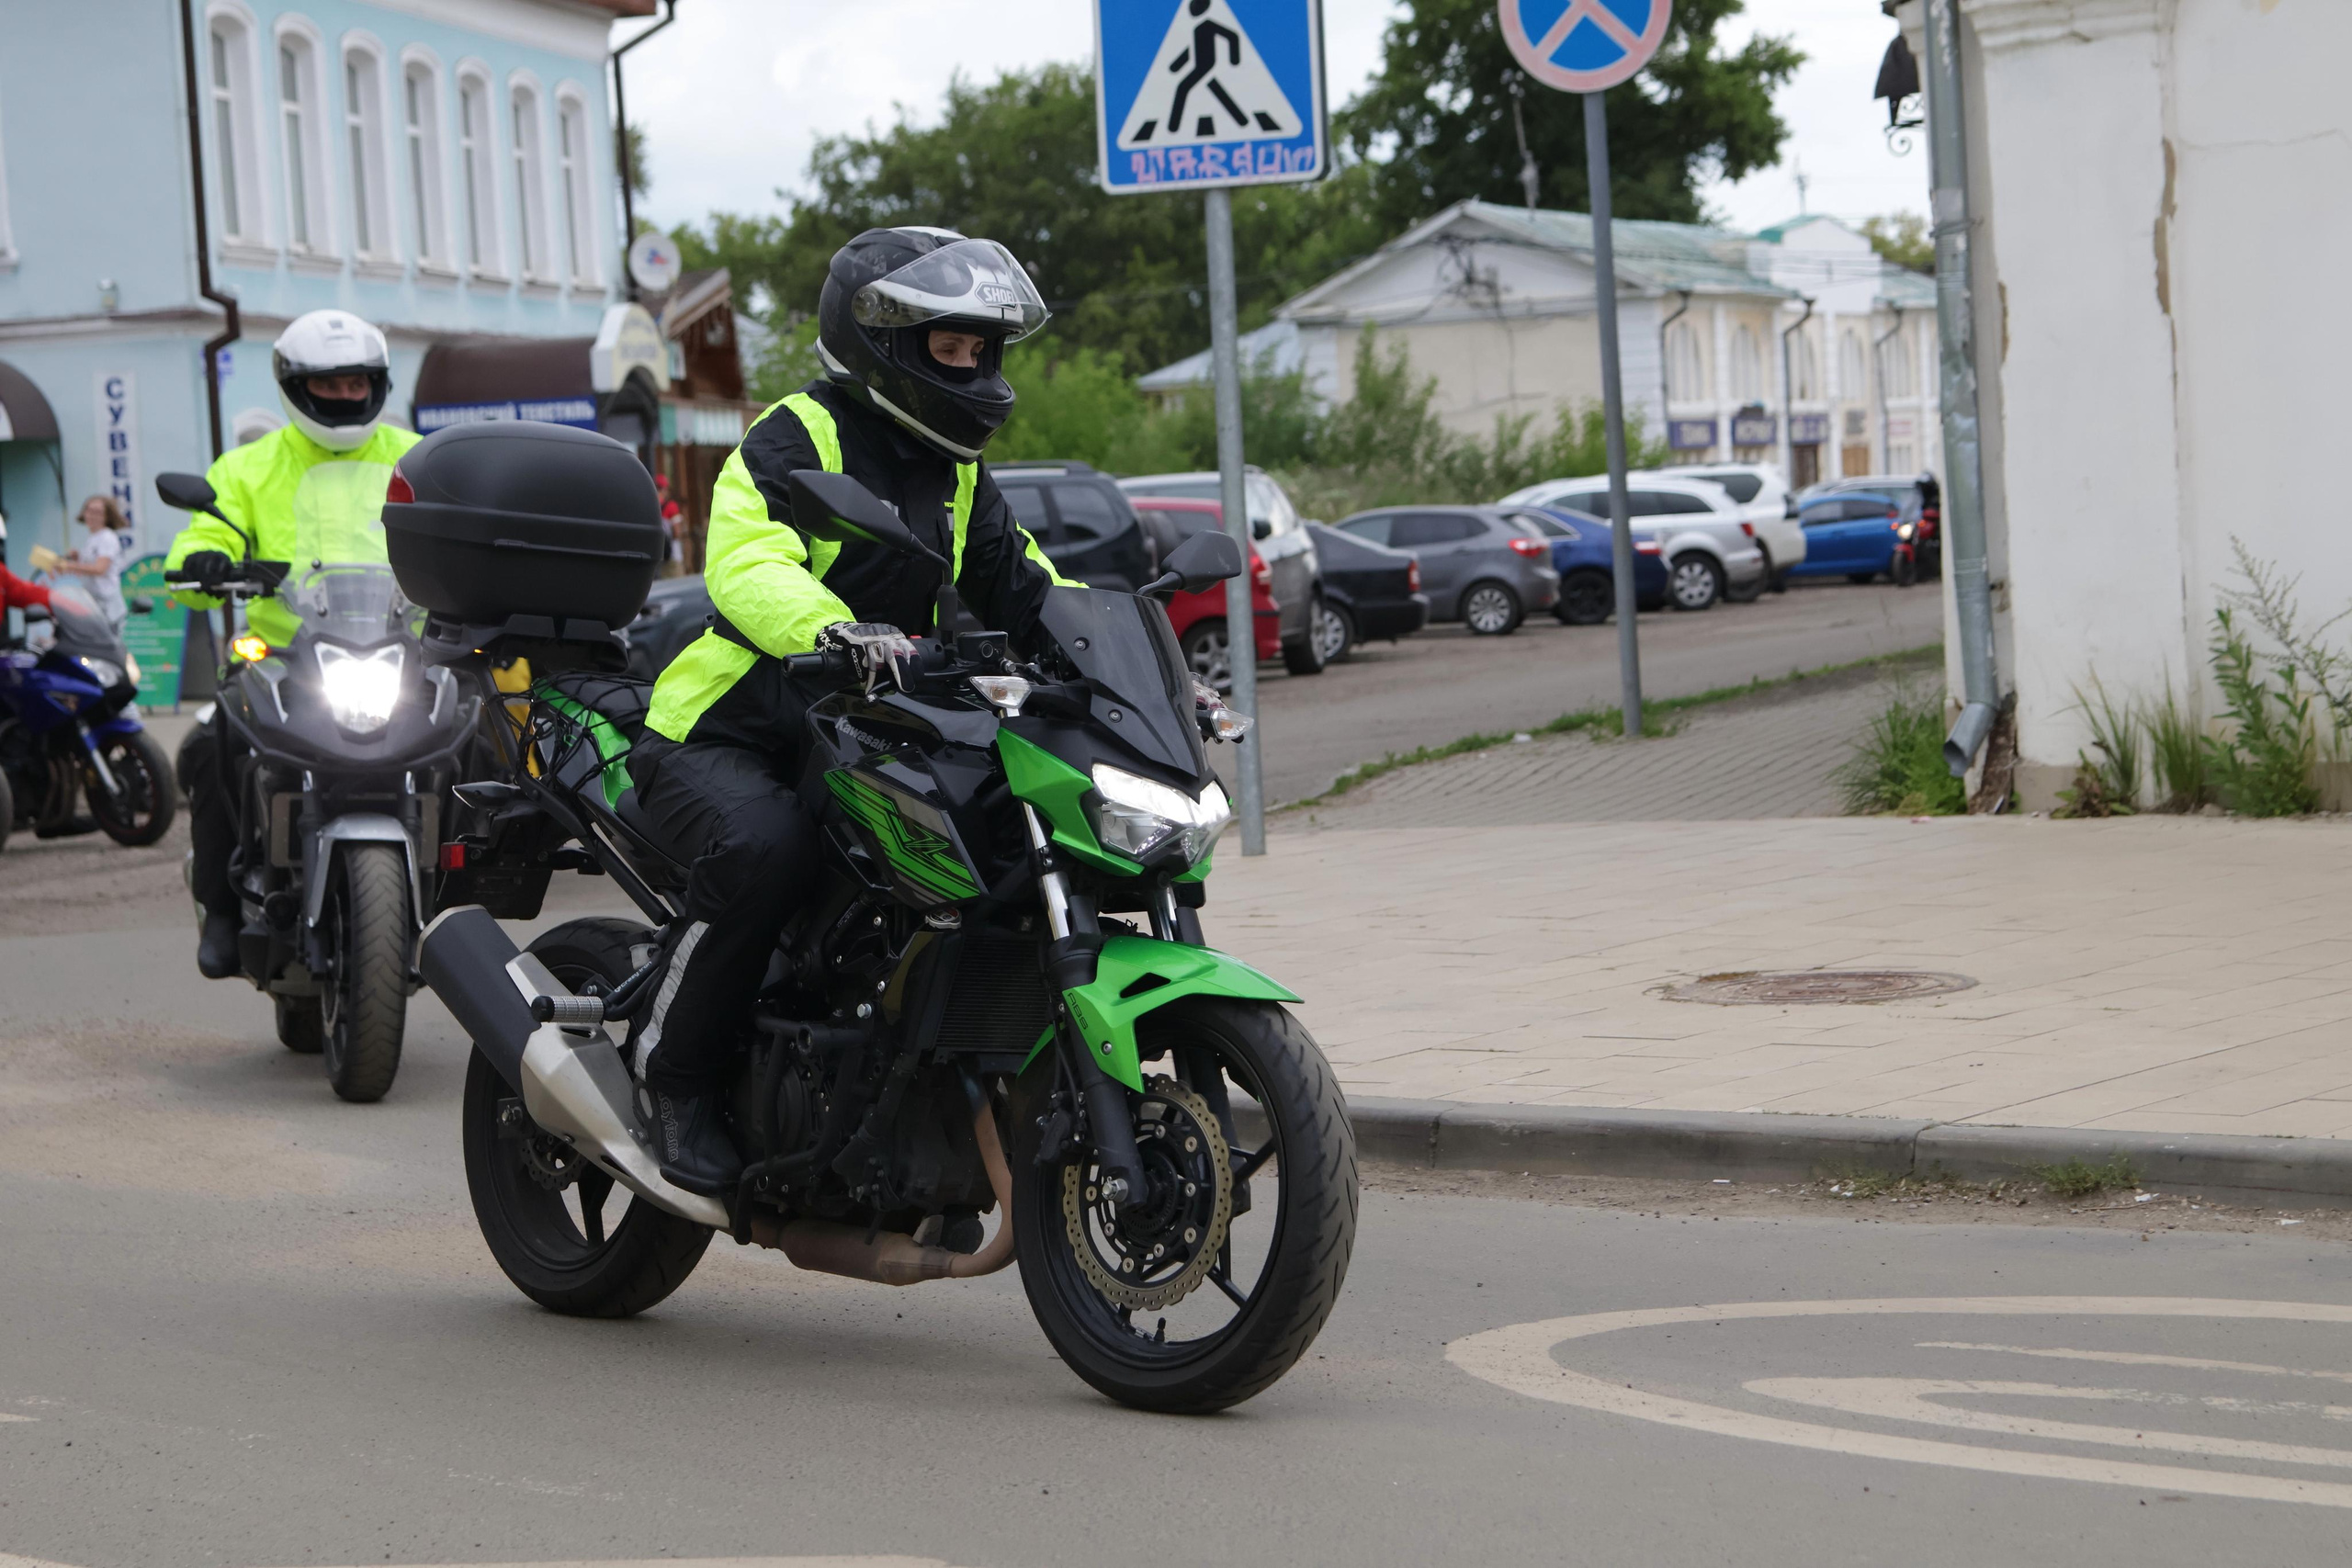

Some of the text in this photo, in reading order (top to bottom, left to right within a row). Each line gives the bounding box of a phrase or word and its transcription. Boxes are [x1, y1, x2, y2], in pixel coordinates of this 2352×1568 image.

[835, 716, 892, 751] Kawasaki
[1068, 992, 1089, 1030] ABS
[658, 1090, 679, 1163] aytona
